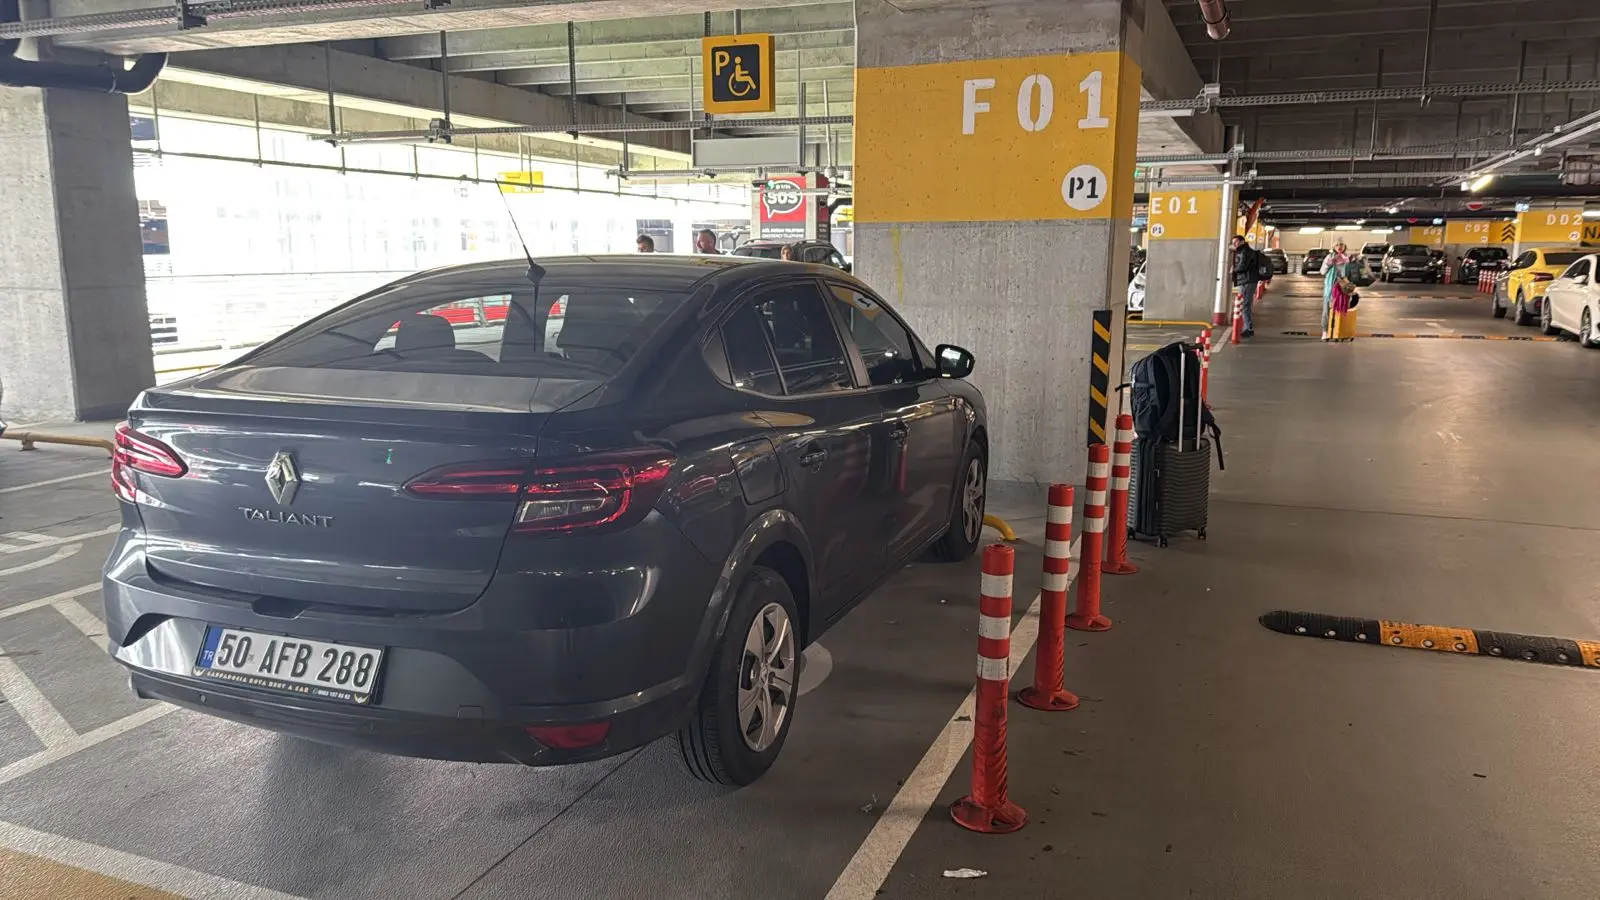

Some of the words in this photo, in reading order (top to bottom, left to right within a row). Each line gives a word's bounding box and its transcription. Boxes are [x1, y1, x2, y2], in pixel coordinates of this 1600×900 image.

[715, 51, 729, 76] P
[767, 191, 798, 205] SOS
[1068, 176, 1099, 199] P1
[238, 506, 334, 529] TALIANT
[202, 649, 214, 661] TR
[217, 633, 252, 669] 50
[257, 638, 313, 678] AFB
[316, 647, 374, 688] 288
